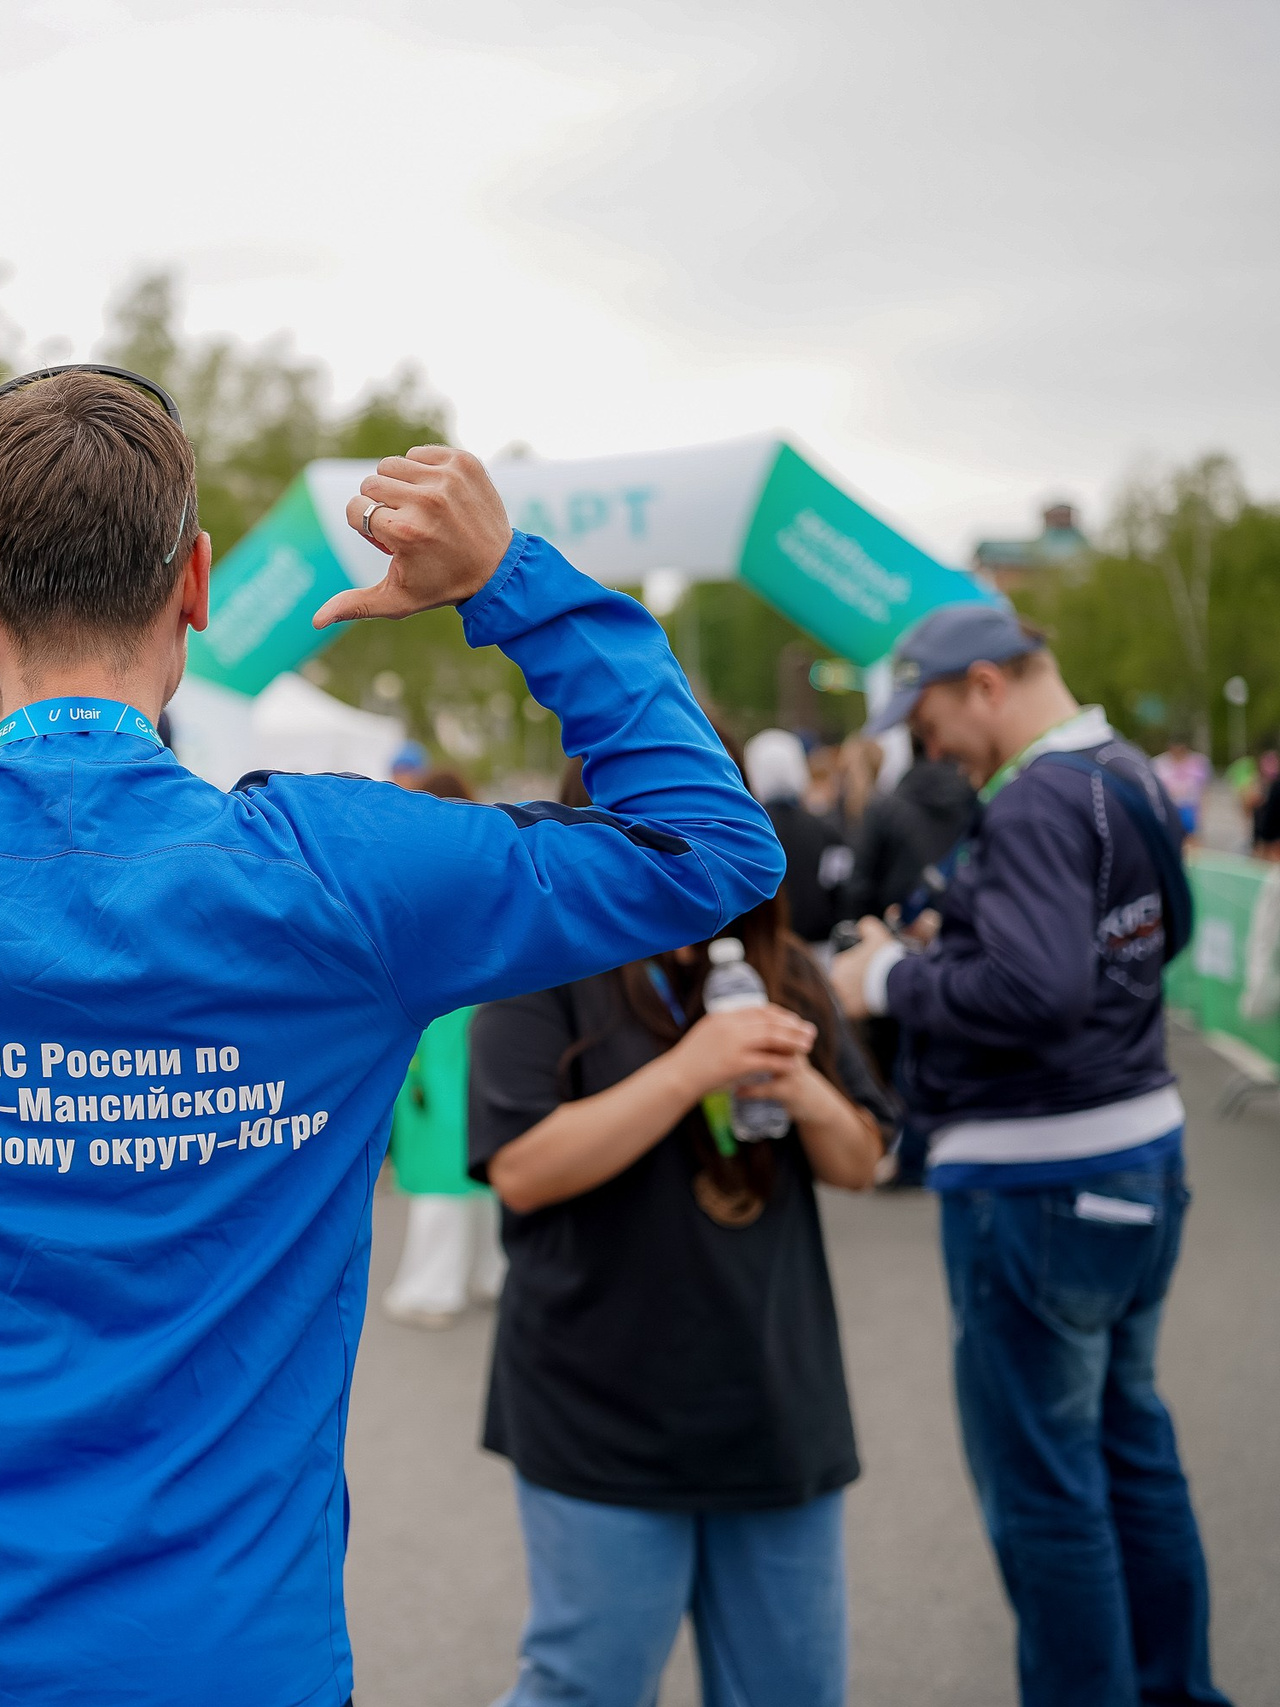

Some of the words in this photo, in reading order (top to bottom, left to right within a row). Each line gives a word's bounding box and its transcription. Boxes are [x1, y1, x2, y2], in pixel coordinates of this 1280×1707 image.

[70, 708, 101, 720] Utair
[41, 1043, 181, 1078] России
[196, 1046, 239, 1073] по
